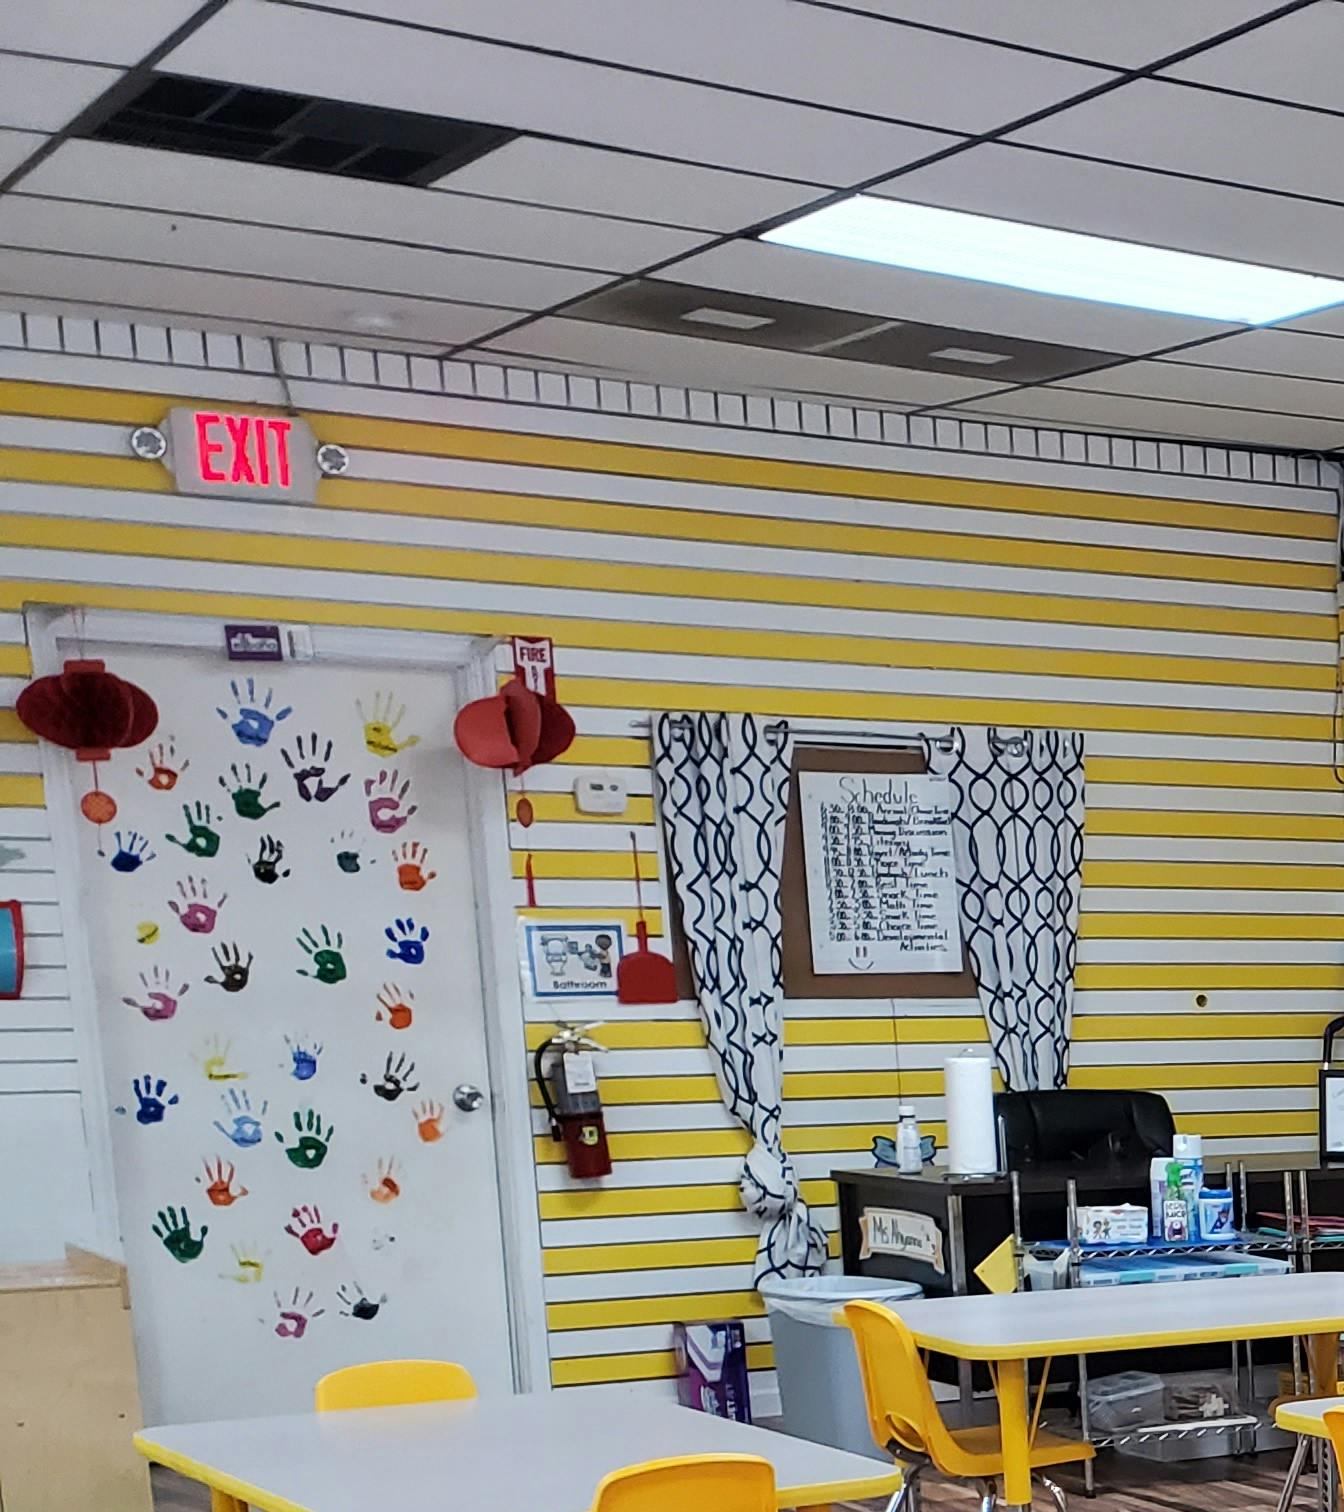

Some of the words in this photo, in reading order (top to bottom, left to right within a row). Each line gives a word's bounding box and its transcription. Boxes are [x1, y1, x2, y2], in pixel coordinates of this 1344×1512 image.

[195, 413, 292, 487] EXIT
[520, 647, 546, 663] FIRE
[839, 777, 918, 804] Schedule
[553, 981, 608, 990] Bathroom
